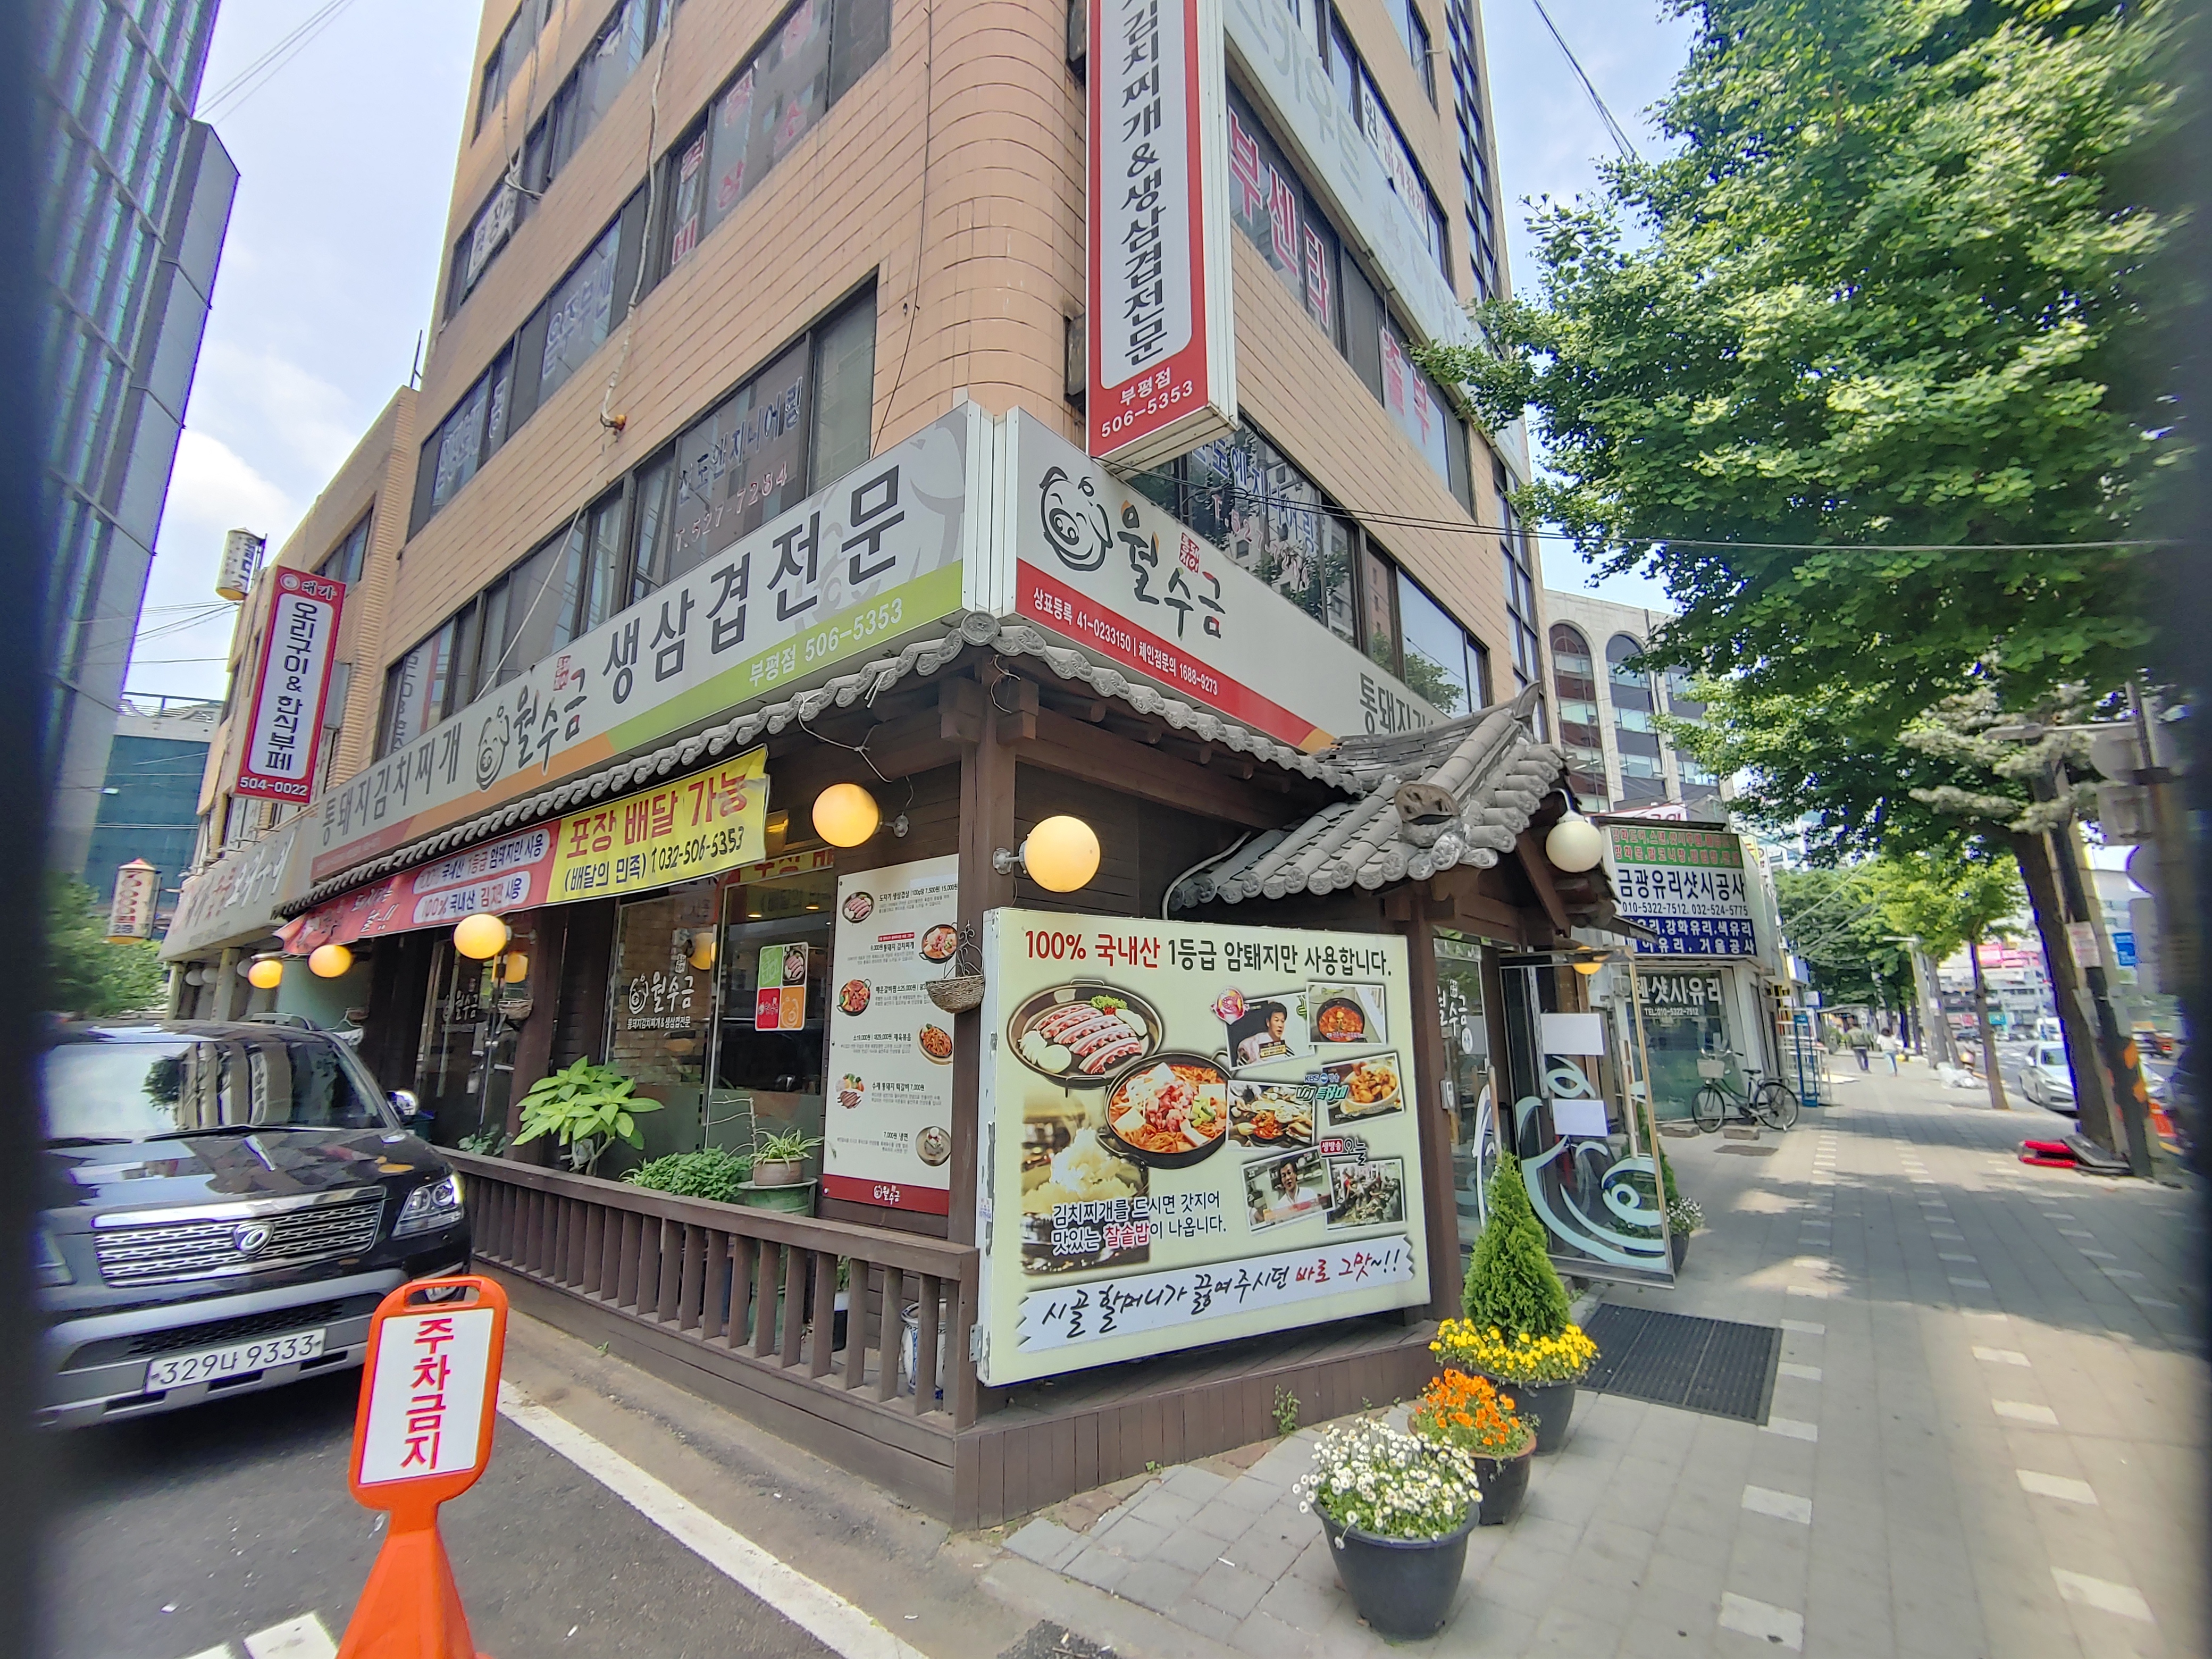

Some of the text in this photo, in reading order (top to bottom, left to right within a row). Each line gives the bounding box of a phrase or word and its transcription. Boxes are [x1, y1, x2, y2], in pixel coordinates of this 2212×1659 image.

[1120, 367, 1171, 406] 부평점
[1101, 380, 1193, 438] 506-5353
[1117, 500, 1226, 641] 월수금
[322, 722, 462, 847] 통돼지김치찌개
[601, 464, 906, 705] 생삼겹전문
[748, 597, 903, 687] 부평점 506-5353
[1033, 588, 1218, 696] 상표등록 41-0233150 체인점문의 1688-9273
[239, 777, 307, 797] 504-0022
[524, 833, 543, 858] 사용
[567, 809, 616, 859] 포장
[624, 790, 678, 846] 배달
[564, 860, 610, 893] (배달의
[616, 851, 647, 884] 민족)
[422, 895, 449, 918] 100%
[450, 889, 475, 913] 국내산
[506, 877, 522, 900] 사용
[1691, 904, 1749, 916] 032-524-5775
[1025, 930, 1392, 977] 100% 국내산 1등급 암퇘지만 사용합니다.
[650, 971, 695, 1014] 월수금
[1295, 1085, 1316, 1101] VJ
[1304, 1074, 1319, 1083] KBS
[1321, 1140, 1343, 1153] 생방송
[1052, 1190, 1220, 1227] 김치찌개를 드시면 갓지어
[1052, 1227, 1100, 1255] 맛있는
[1169, 1214, 1227, 1238] 나옵니다.
[1042, 1288, 1090, 1339] 시골
[1099, 1283, 1187, 1333] 할머니가
[1296, 1258, 1330, 1284] 바로
[160, 1334, 314, 1385] 329나 9333
[400, 1318, 454, 1470] 주차금지
